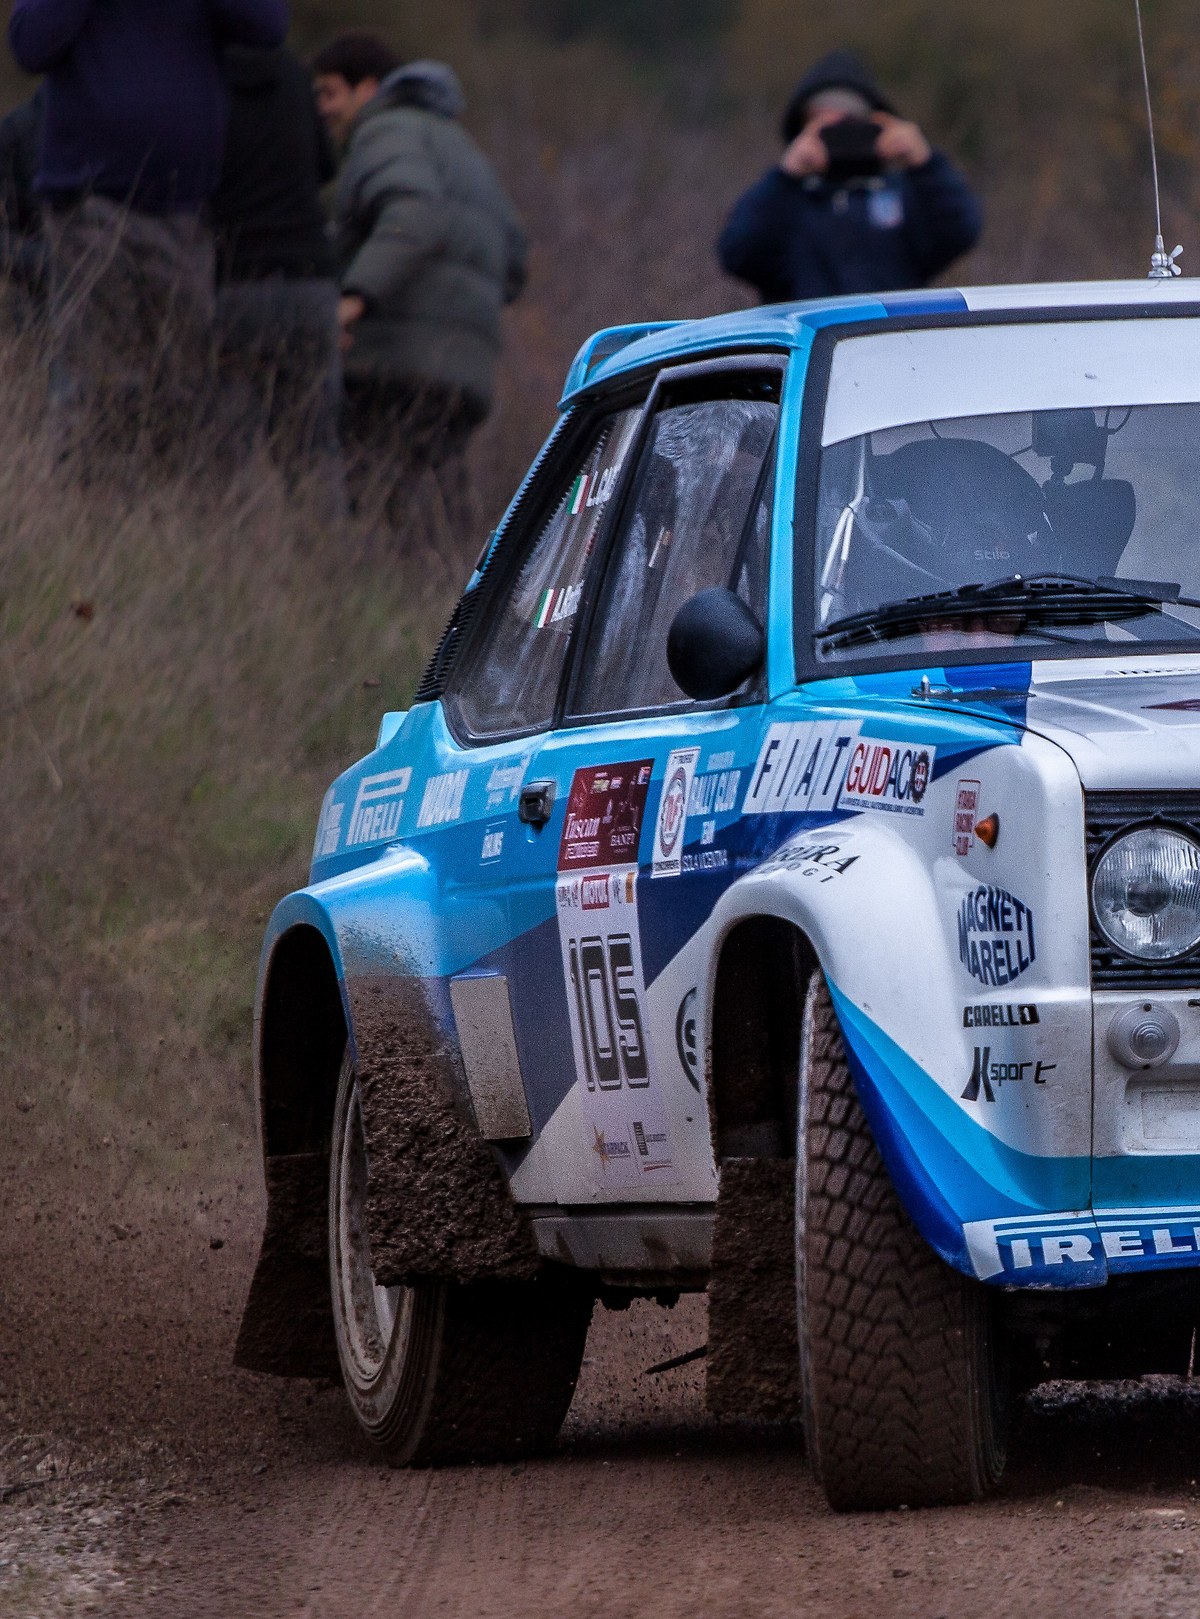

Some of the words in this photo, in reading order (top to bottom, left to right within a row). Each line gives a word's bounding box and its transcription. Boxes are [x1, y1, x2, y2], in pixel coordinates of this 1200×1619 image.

[346, 766, 413, 846] PIRELLI
[753, 737, 851, 798] FIAT
[569, 932, 650, 1092] 105
